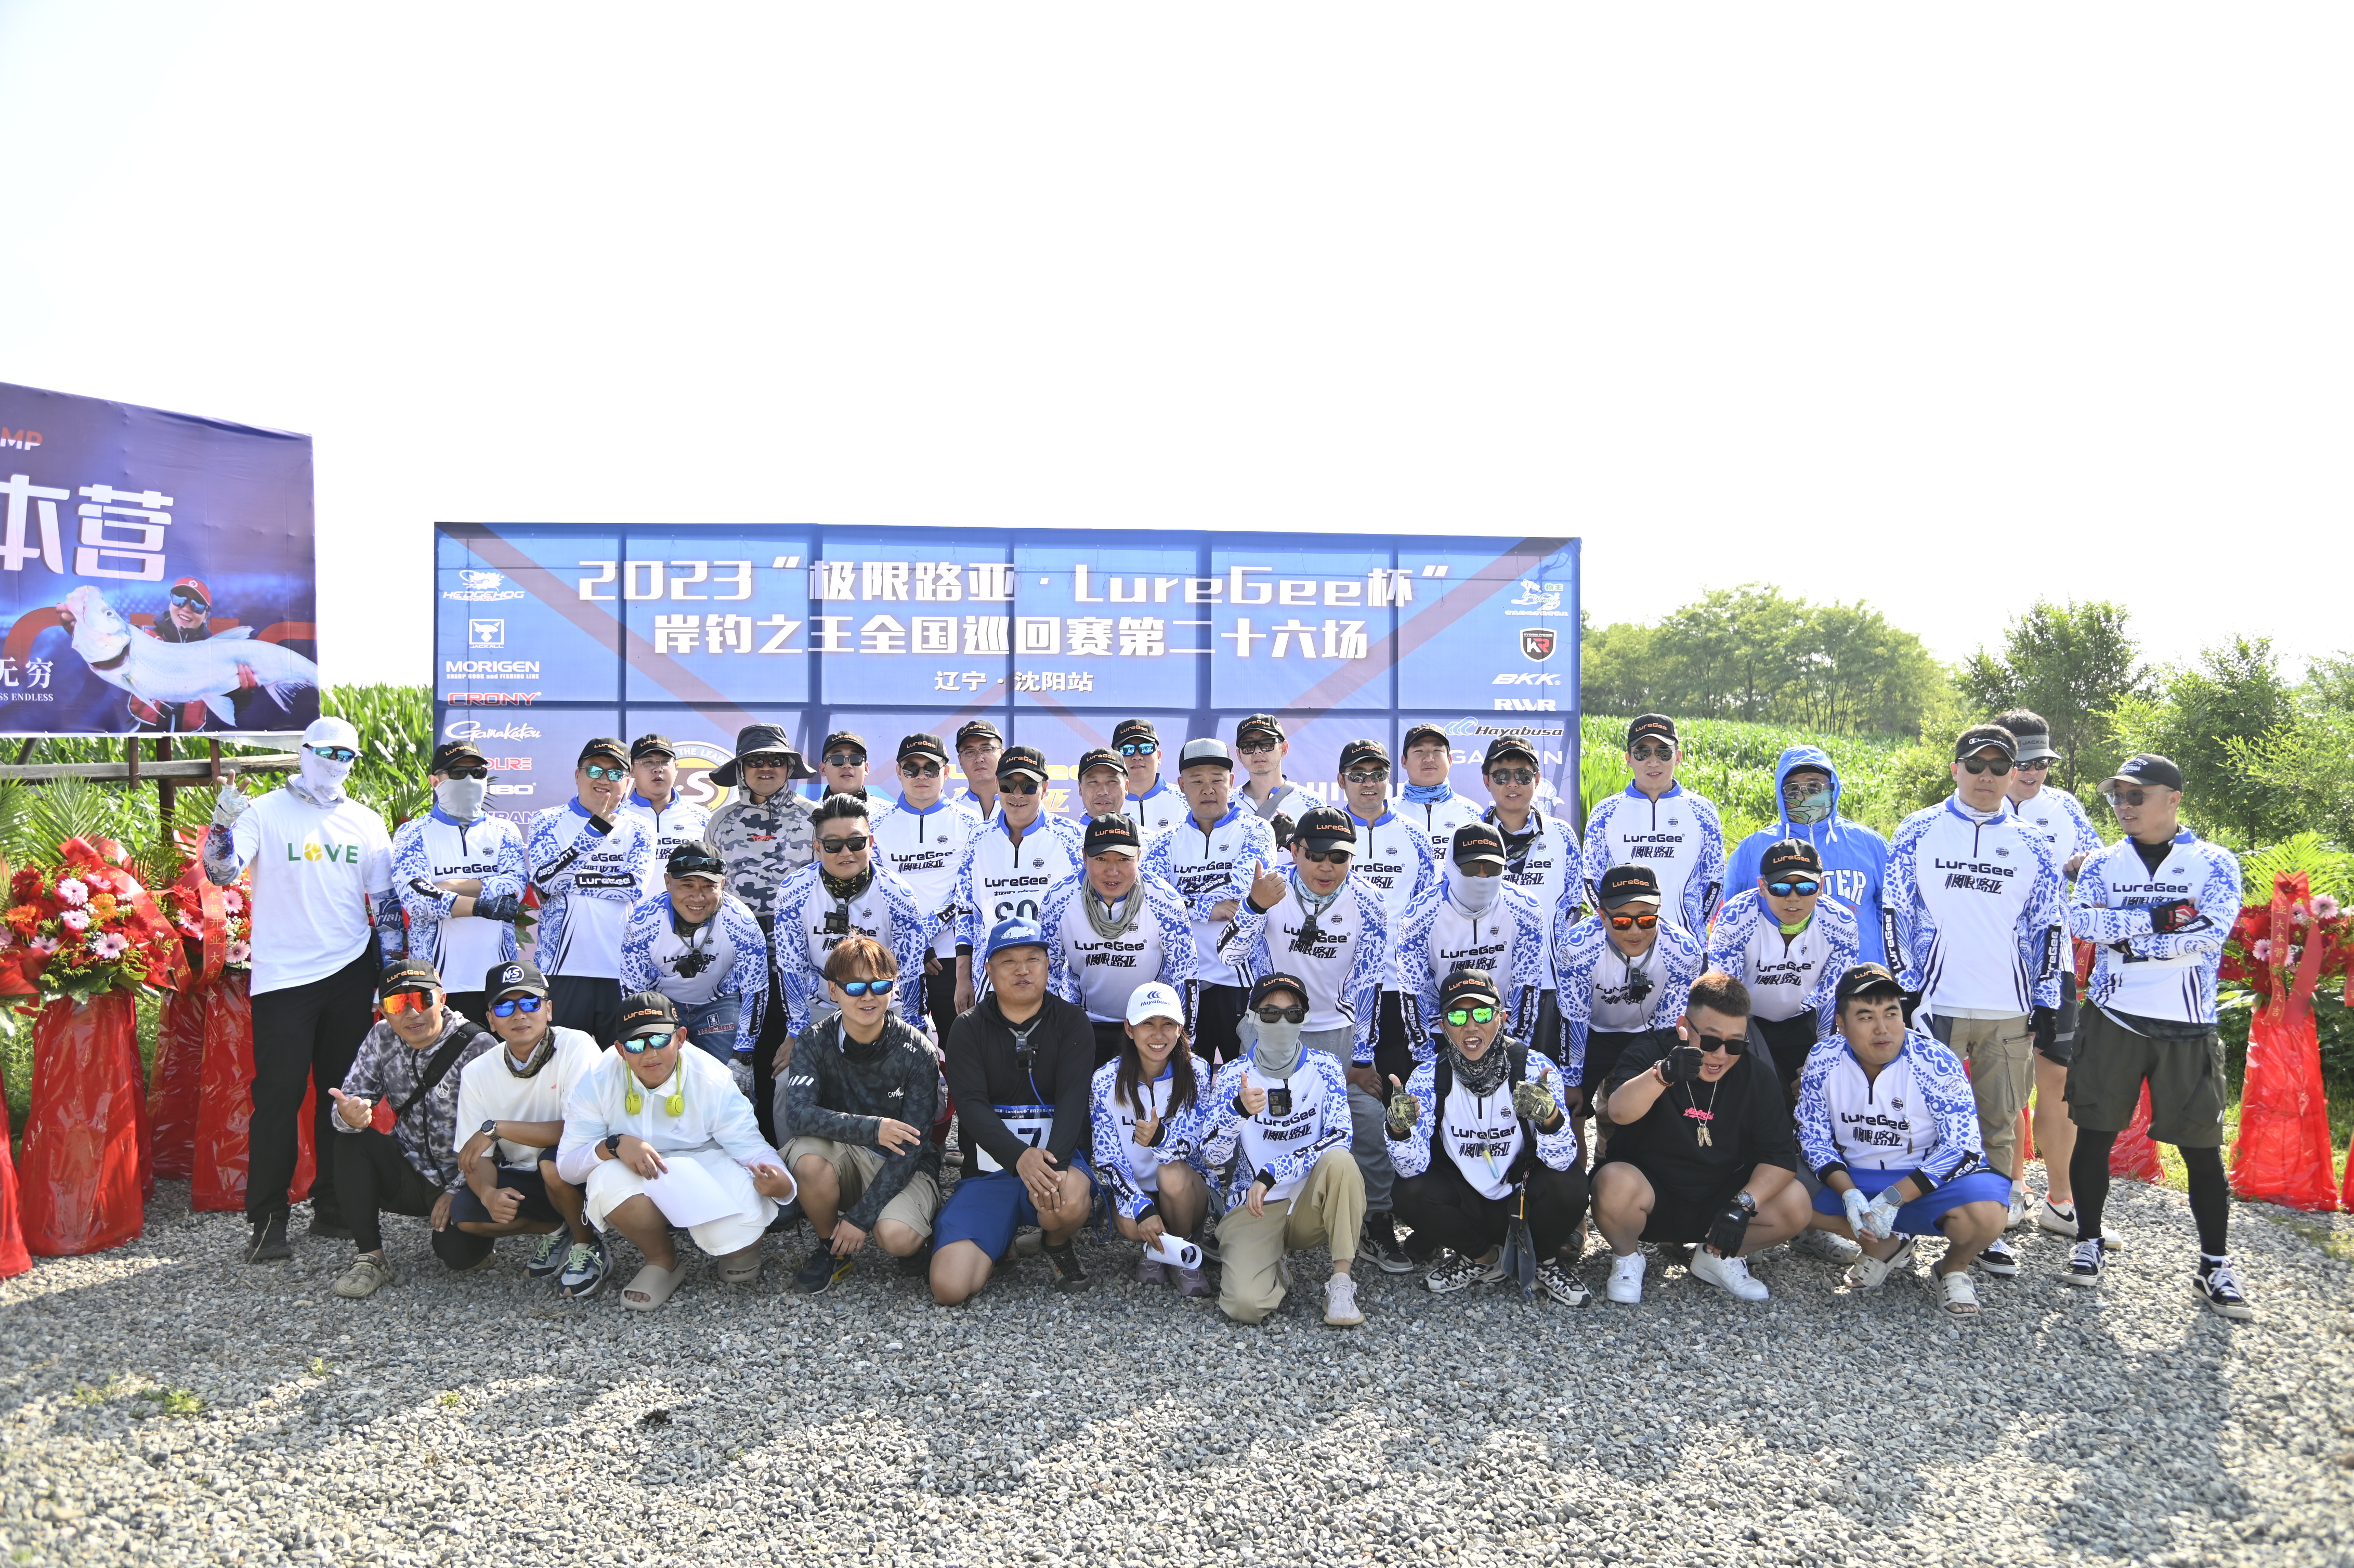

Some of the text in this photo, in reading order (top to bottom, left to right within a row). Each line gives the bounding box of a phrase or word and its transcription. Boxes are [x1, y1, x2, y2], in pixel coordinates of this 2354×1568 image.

[655, 614, 1368, 659] 岸钓之王全国巡回赛第二十六场
[1527, 638, 1550, 653] KR
[446, 661, 540, 672] MORIGEN
[0, 657, 54, 688] 无穷
[934, 671, 1094, 692] 辽宁·沈阳站
[12, 693, 54, 701] ENDLESS
[448, 692, 542, 705] CRONY
[1494, 698, 1557, 711] RWR
[1120, 725, 1148, 734] LureGee
[1242, 720, 1270, 729] LureGee
[1636, 723, 1667, 732] LureGee
[444, 721, 542, 742] Gamakatsu
[960, 725, 987, 736] LureGee
[1474, 726, 1565, 737] Hayabusa
[832, 734, 860, 742] LureGee
[594, 743, 624, 756] LureGee
[907, 740, 936, 749] LureGee
[1351, 745, 1382, 754] LureGee
[1498, 740, 1529, 750] LureGee
[445, 746, 478, 756] LureGee
[1006, 756, 1038, 766] LureGee
[1086, 753, 1117, 762] LureGee
[1316, 824, 1351, 834] LureGee
[1624, 834, 1682, 843] LureGee
[891, 851, 953, 863] LureGee
[1631, 845, 1675, 858] 极限路亚
[1773, 854, 1810, 864] LureGee
[434, 863, 498, 877] LureGee
[1174, 861, 1232, 873] LureGee
[1351, 863, 1402, 873] reGee
[1935, 858, 2013, 877] LureGee
[579, 877, 631, 885] LureGee
[985, 877, 1048, 888] LureGee
[1612, 879, 1650, 887] LureGee
[1945, 873, 2005, 895] 极限路亚
[2113, 882, 2188, 893] LureGee
[1075, 940, 1144, 951] LureGee
[1885, 914, 1902, 970] LureGee
[1440, 943, 1505, 959] LureGee
[1086, 953, 1137, 967] 极限路亚
[1757, 960, 1811, 972] LureGee
[387, 970, 426, 983] LureGee
[1854, 970, 1892, 980] LureGee
[1263, 977, 1300, 988] LureGee
[1448, 979, 1486, 990] LureGee
[624, 1009, 663, 1021] LureGee
[1407, 999, 1424, 1042] LureGee
[1254, 1106, 1317, 1127] LureGee
[1841, 1112, 1911, 1130] LureGee
[1263, 1123, 1312, 1141] 极限路亚
[1853, 1127, 1903, 1147] 极限路亚
